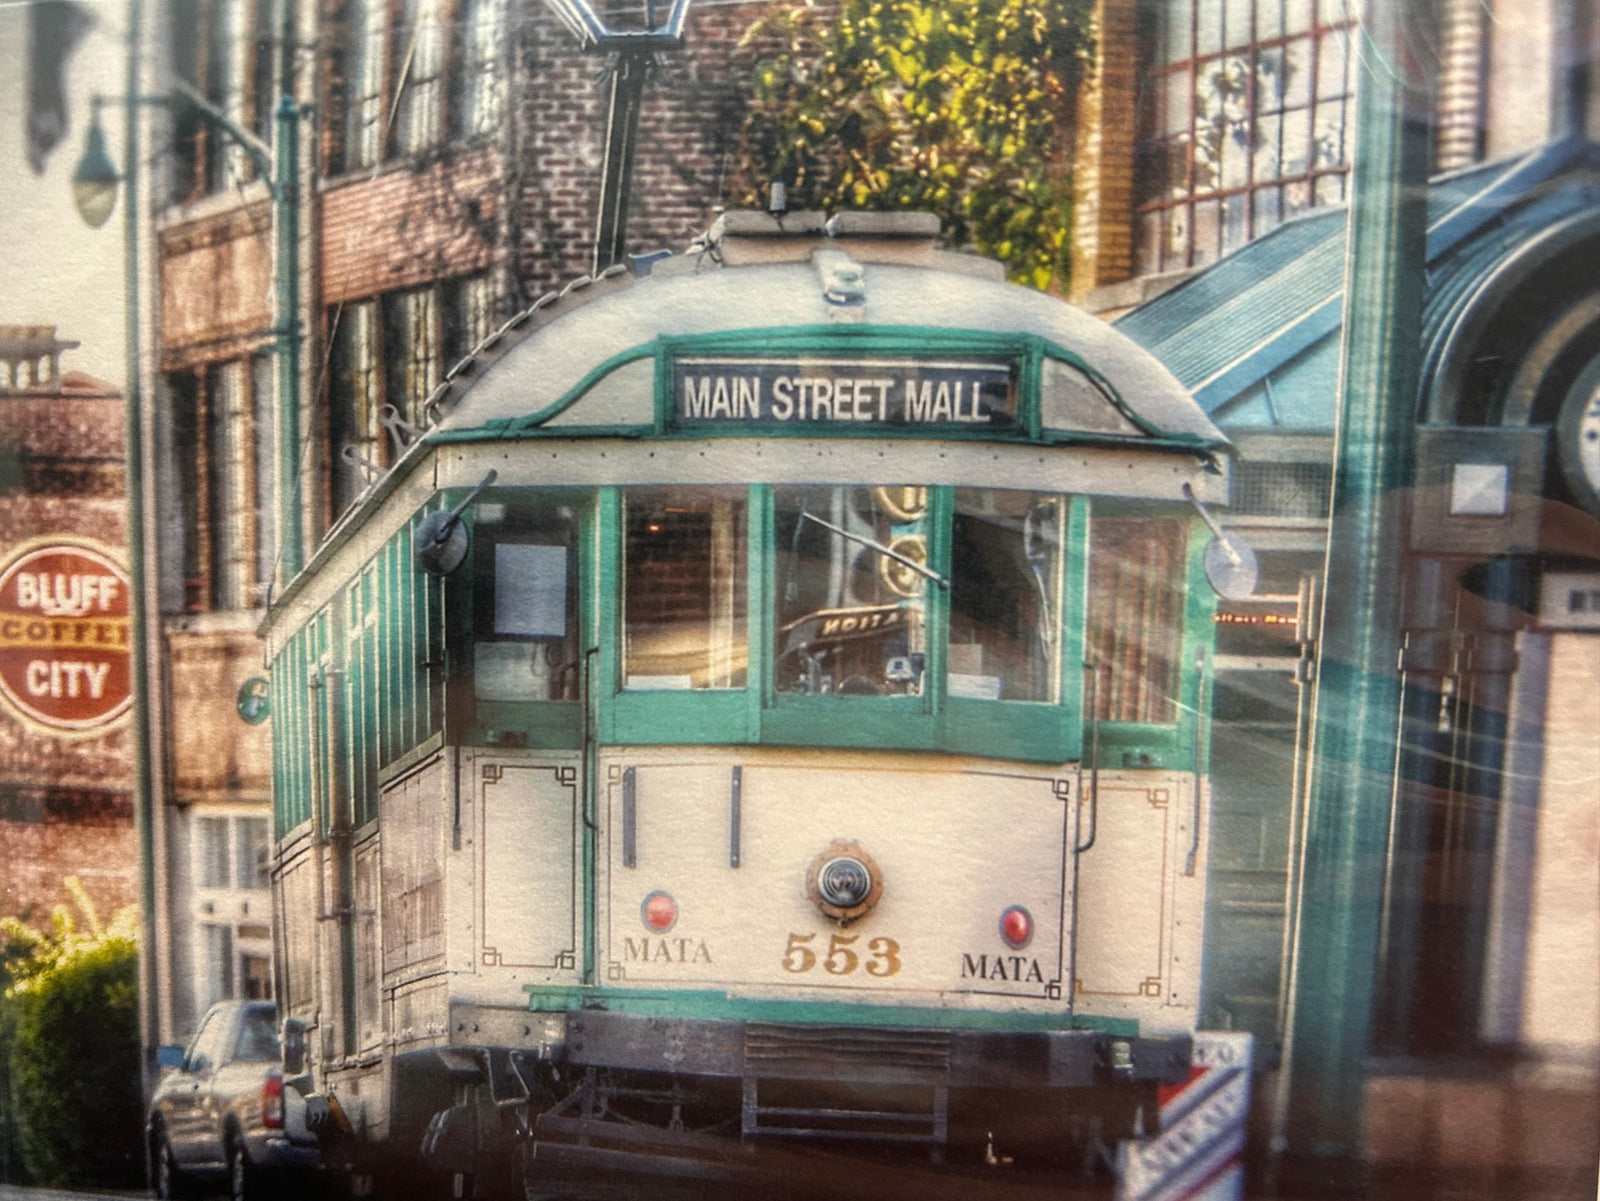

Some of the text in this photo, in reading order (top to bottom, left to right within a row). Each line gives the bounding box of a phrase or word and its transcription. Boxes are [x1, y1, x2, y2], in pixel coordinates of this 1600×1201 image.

[683, 376, 991, 422] MAIN STREET MALL
[17, 572, 119, 616] BLUFF
[26, 660, 110, 699] CITY
[623, 937, 713, 964] MATA
[781, 932, 901, 977] 553
[961, 952, 1044, 983] MATA
